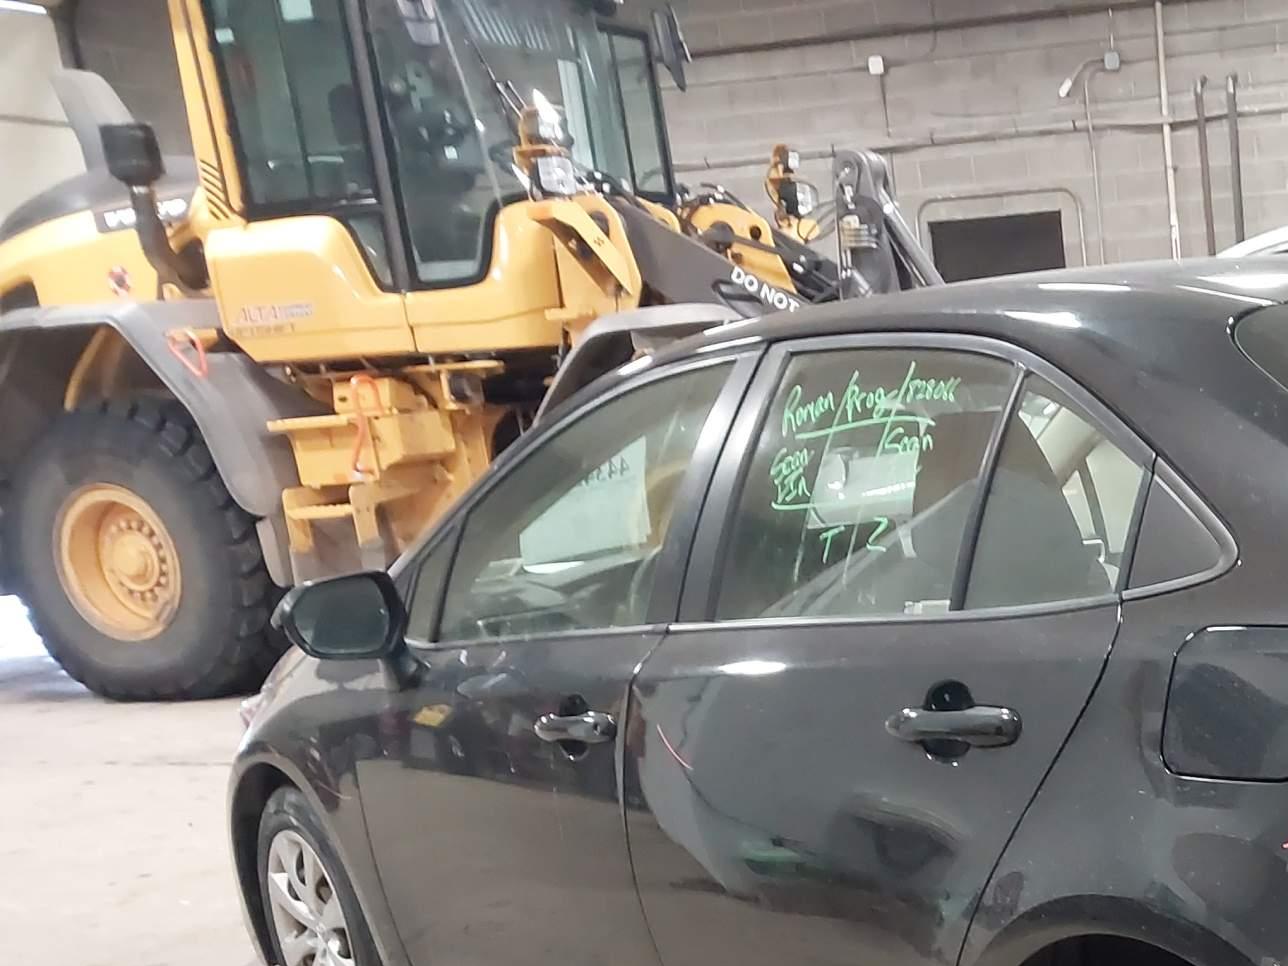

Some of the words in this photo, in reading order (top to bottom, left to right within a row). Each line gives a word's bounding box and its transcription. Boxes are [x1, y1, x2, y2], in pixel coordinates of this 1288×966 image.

[104, 198, 187, 228] VOVO
[731, 266, 758, 292] DO
[760, 283, 799, 313] NOT
